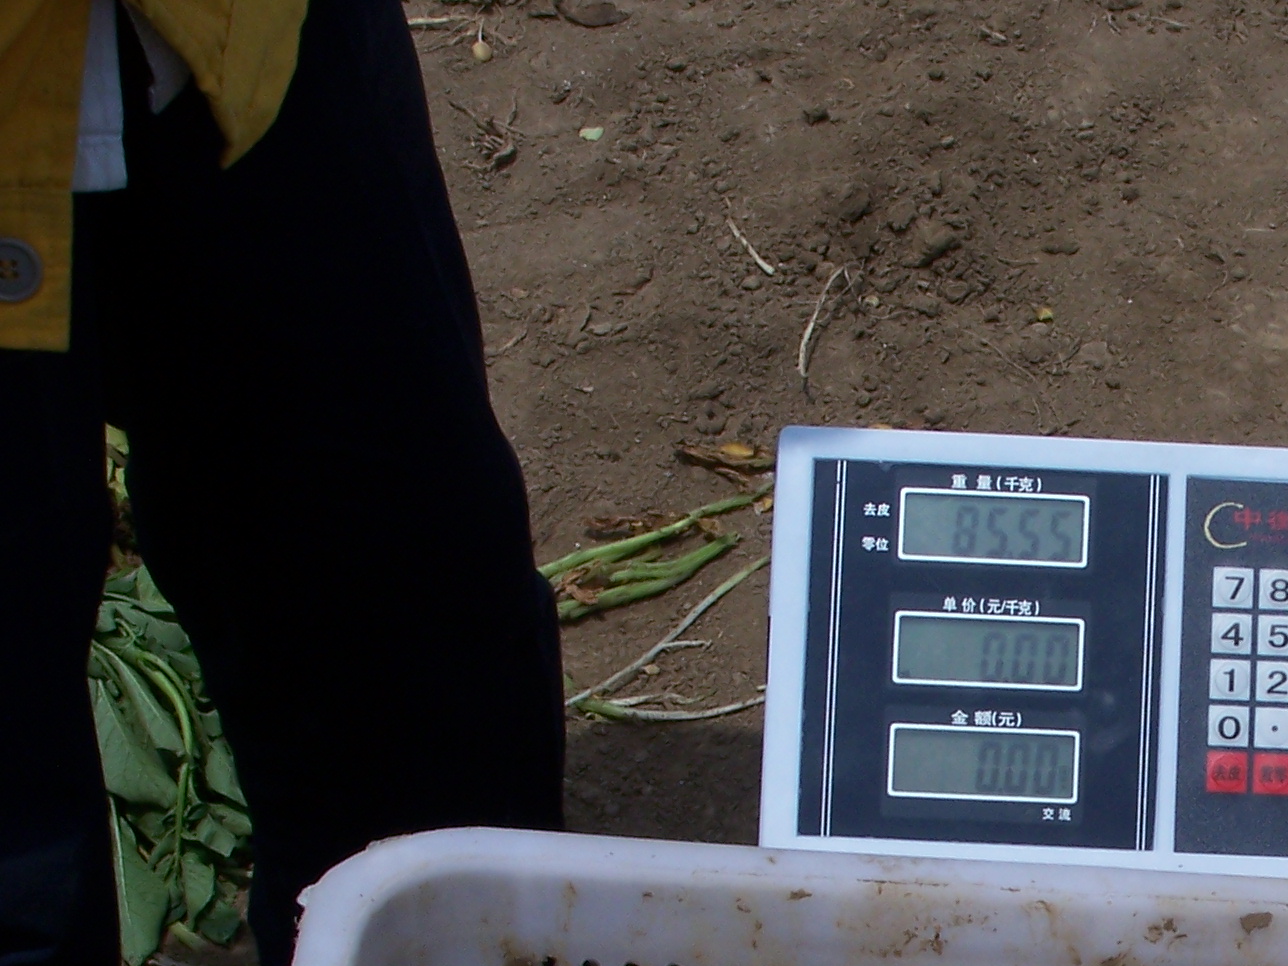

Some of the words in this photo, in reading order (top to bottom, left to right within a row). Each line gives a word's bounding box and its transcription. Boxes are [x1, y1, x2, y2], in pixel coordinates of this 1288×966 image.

[863, 502, 891, 517] 去皮
[861, 537, 889, 551] 零位
[1225, 576, 1245, 600] 7
[1221, 622, 1243, 646] 4
[1223, 668, 1236, 692] 1
[1266, 670, 1288, 695] 2
[1217, 716, 1241, 739] 0
[1042, 807, 1071, 821] 交流
